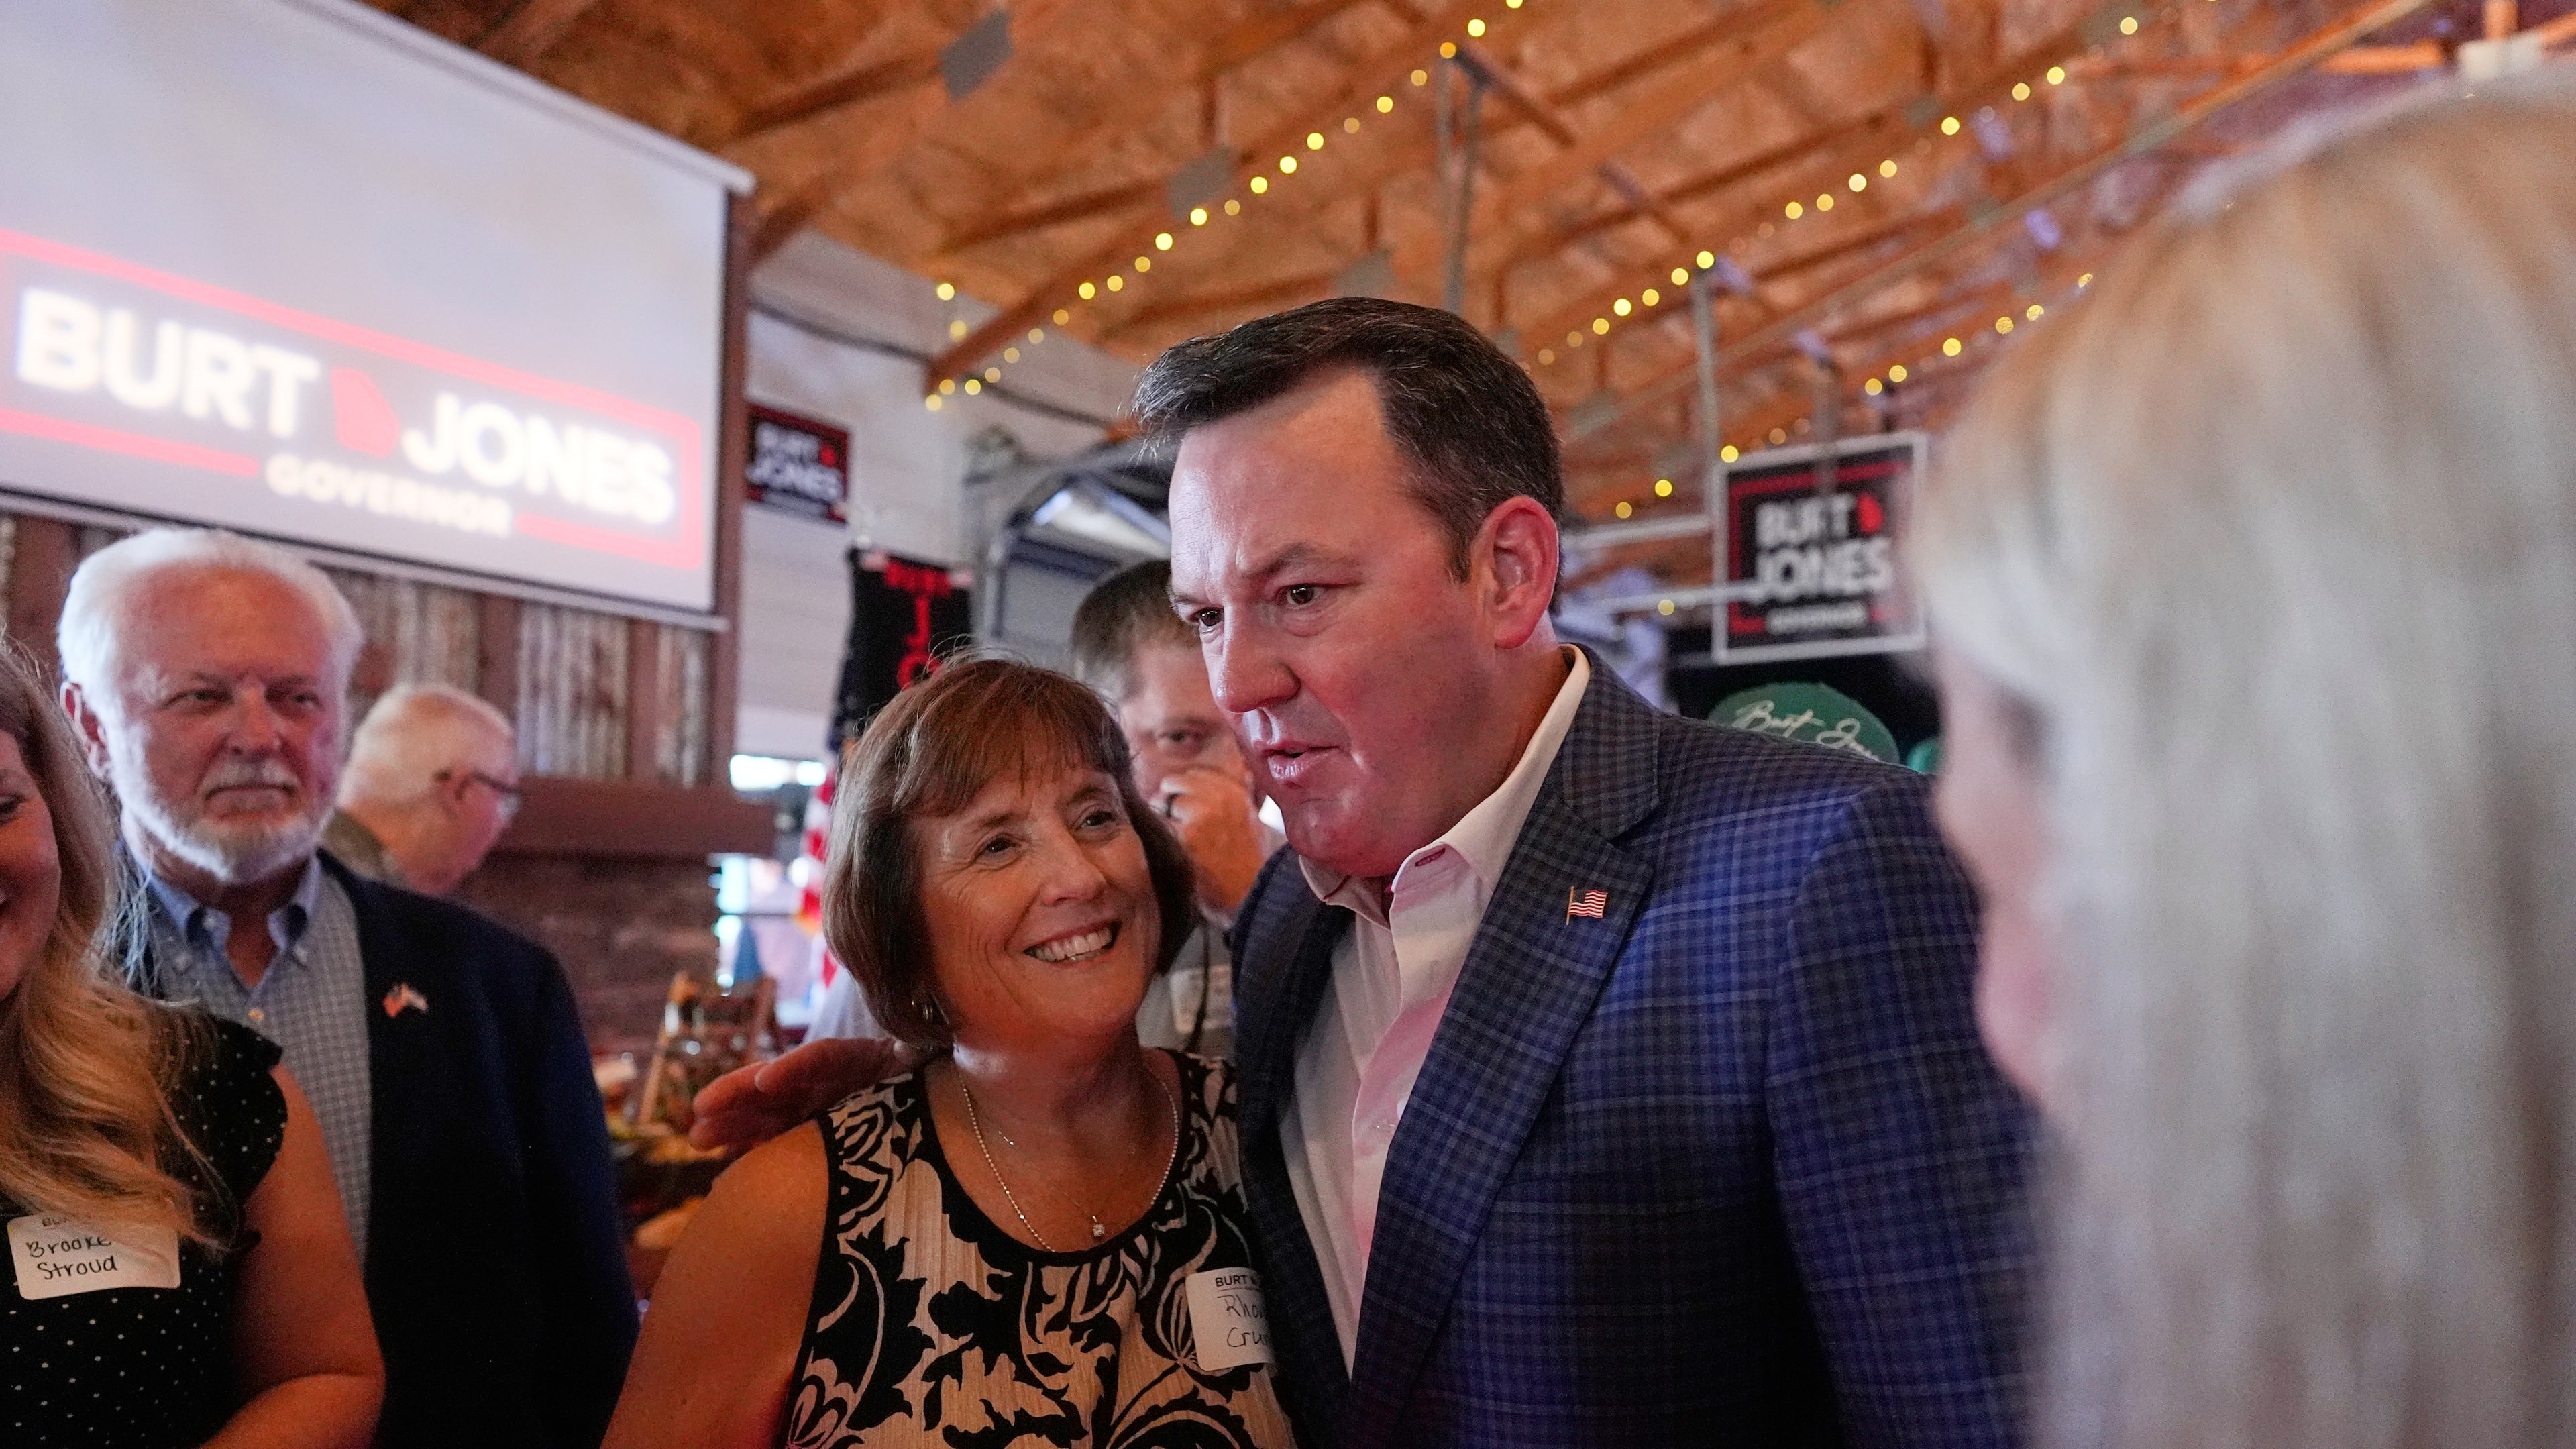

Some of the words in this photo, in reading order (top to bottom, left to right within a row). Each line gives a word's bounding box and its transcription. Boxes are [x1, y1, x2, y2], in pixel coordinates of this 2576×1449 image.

[17, 286, 321, 438] BURT
[401, 392, 676, 525] JONES
[745, 454, 845, 504] JONES
[1756, 494, 1856, 548] BURT
[1741, 535, 1893, 602] JONES
[25, 1236, 112, 1258] Brooke
[36, 1255, 118, 1280] Stroud
[1215, 1275, 1248, 1287] BURT
[1217, 1294, 1265, 1318] Rho
[1226, 1327, 1267, 1348] Cru
